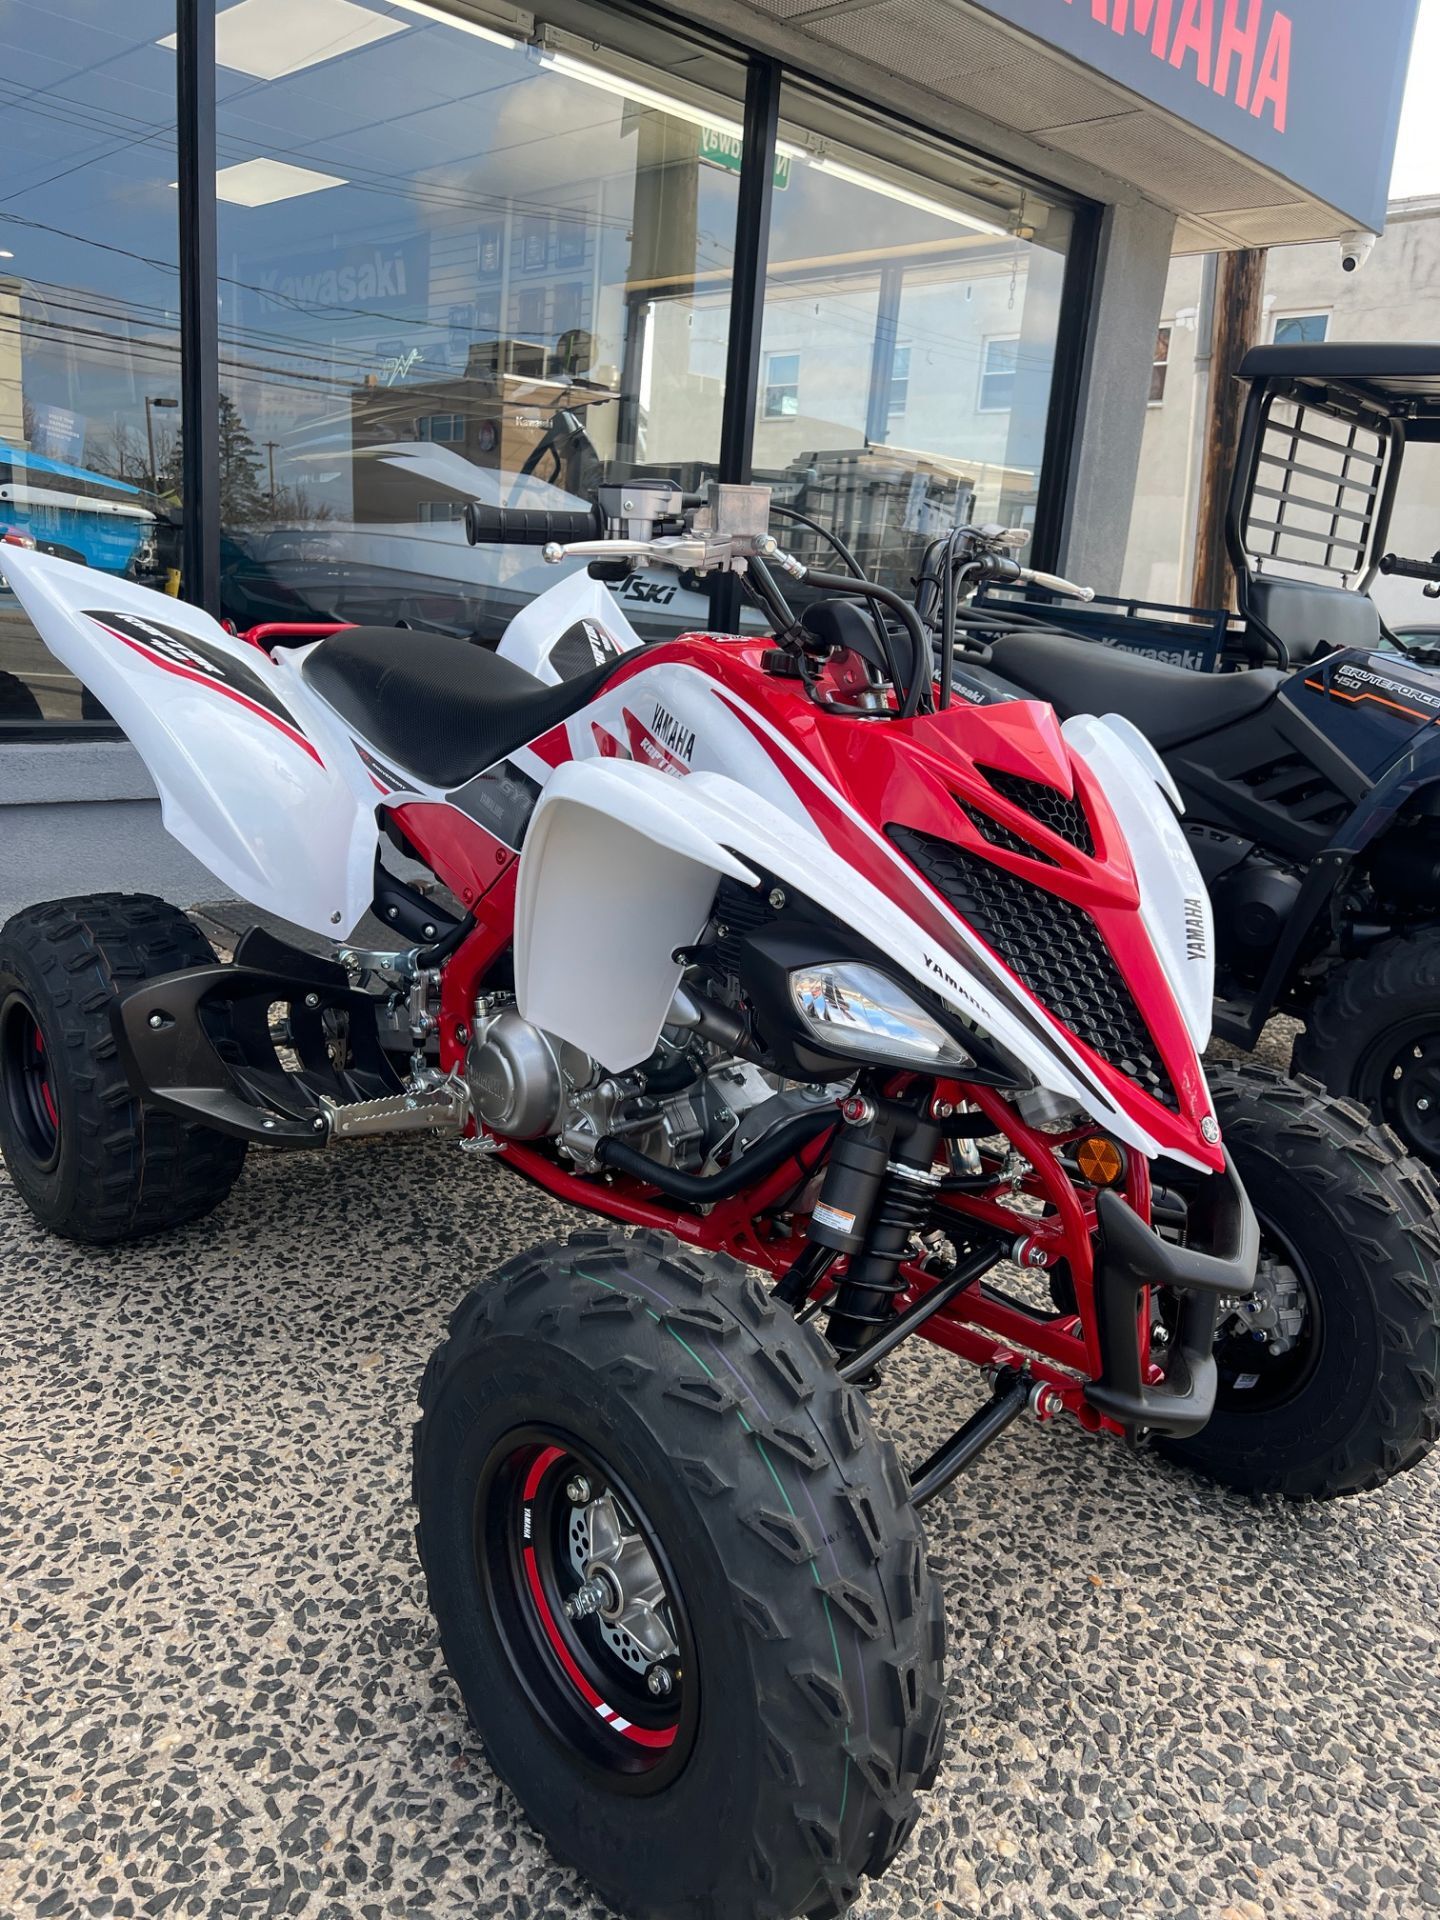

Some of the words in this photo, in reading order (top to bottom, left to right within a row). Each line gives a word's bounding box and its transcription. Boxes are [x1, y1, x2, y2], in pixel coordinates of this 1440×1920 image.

[1064, 0, 1292, 133] MAHA
[259, 250, 407, 314] Kawasaki
[932, 667, 986, 704] Kasaki
[1333, 673, 1362, 690] 450
[651, 702, 696, 763] YAMAHA
[1183, 898, 1206, 961] YAMAHA
[922, 952, 992, 1020] YAMAHA
[523, 1507, 532, 1539] YAMAHA
